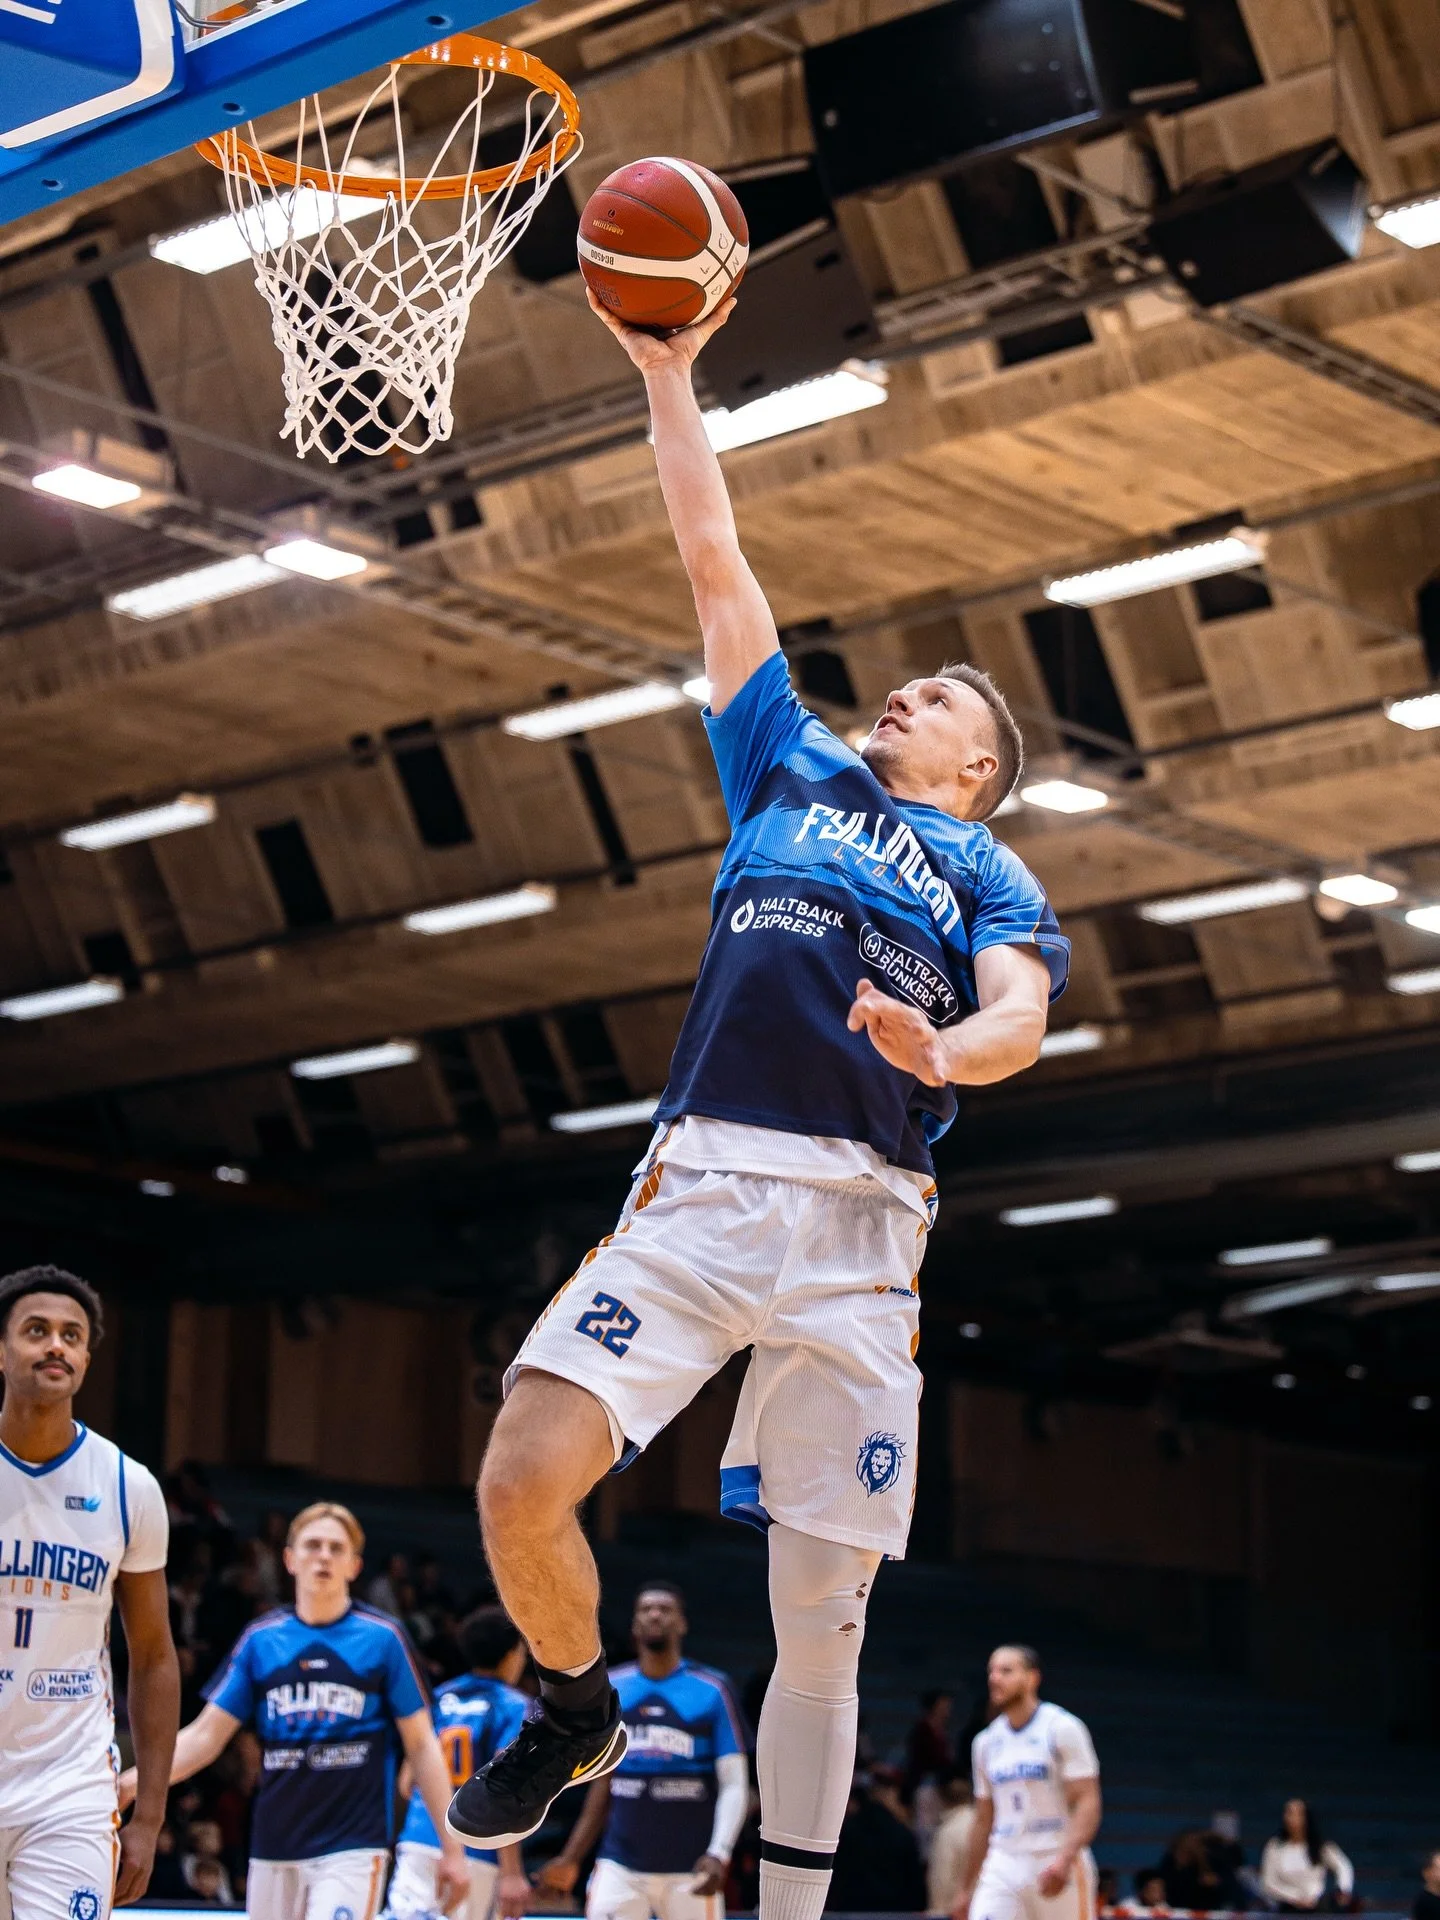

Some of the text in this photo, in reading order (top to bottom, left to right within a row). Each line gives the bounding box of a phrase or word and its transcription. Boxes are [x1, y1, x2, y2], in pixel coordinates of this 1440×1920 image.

[590, 249, 614, 266] BG4500
[794, 802, 960, 936] FYLLINGEN
[752, 914, 827, 938] EXPRESS
[759, 898, 844, 928] HALTBAKK
[880, 954, 937, 1008] BUNKERS
[886, 945, 955, 1009] HALTBAKK
[574, 1289, 642, 1359] 22
[14, 1606, 34, 1649] 11
